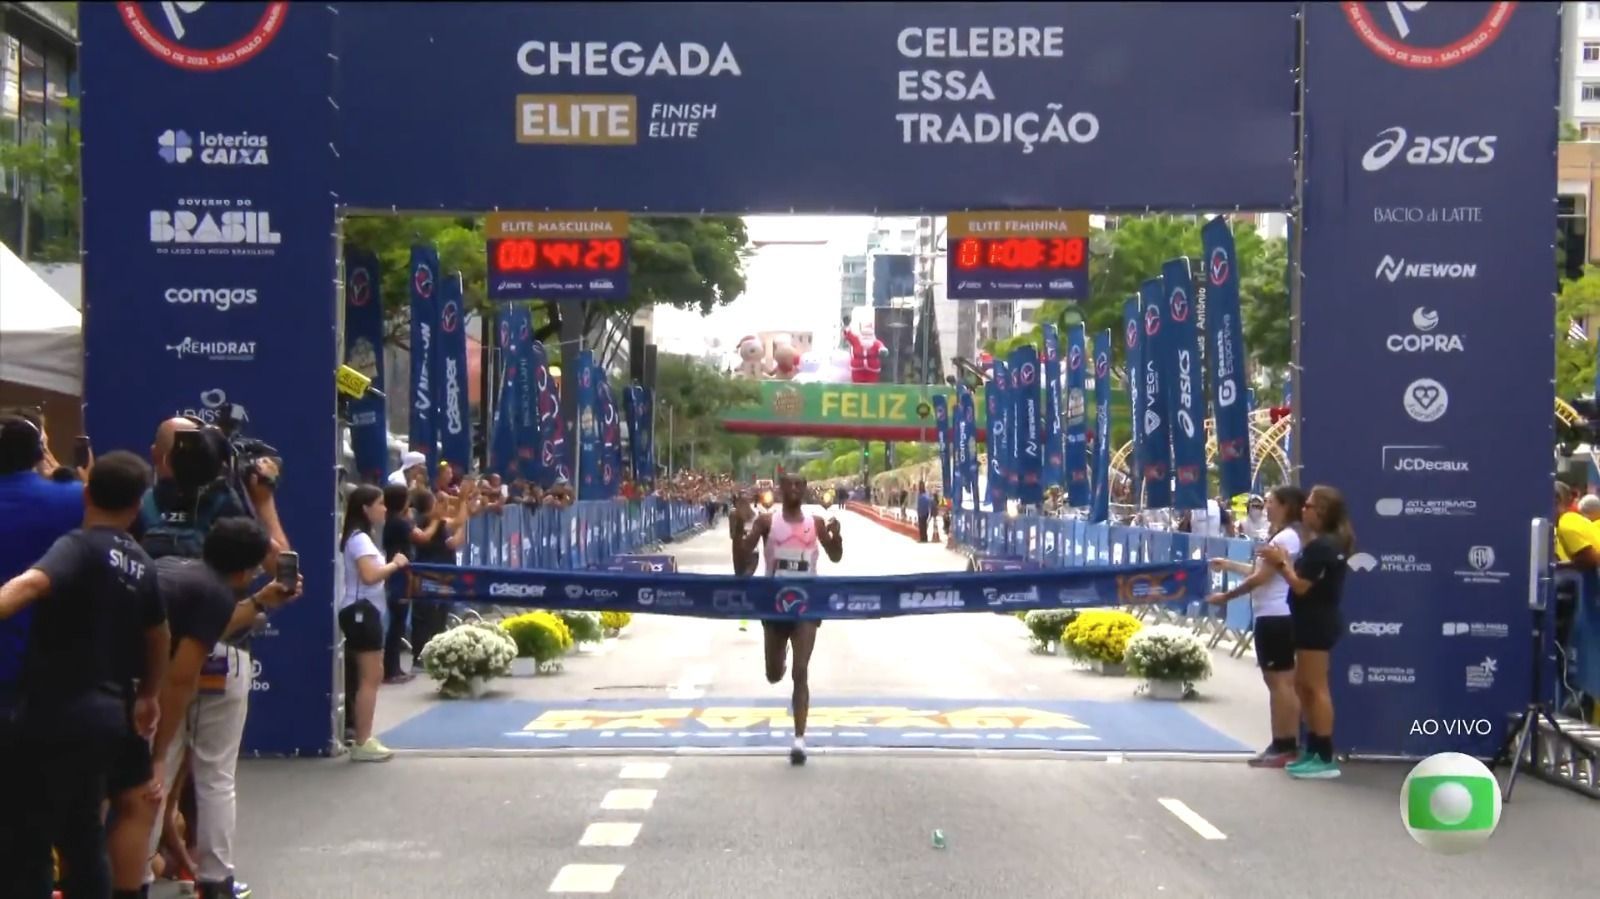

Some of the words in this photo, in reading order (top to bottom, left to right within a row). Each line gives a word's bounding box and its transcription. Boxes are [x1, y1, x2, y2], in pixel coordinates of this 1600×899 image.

[216, 51, 236, 63] SÃO
[235, 35, 262, 57] PAULO
[896, 26, 1064, 59] CELEBRE
[516, 40, 742, 77] CHEGADA
[898, 70, 996, 102] ESSA
[650, 102, 718, 120] FINISH
[521, 103, 631, 138] ELITE
[648, 120, 699, 138] ELITE
[895, 102, 1099, 154] TRADIÇÃO
[200, 131, 269, 148] loterias
[200, 148, 270, 165] CAIXA
[1406, 135, 1498, 164] asics
[178, 198, 230, 206] GOVERNO
[236, 198, 252, 206] DO
[1374, 207, 1423, 222] BACIO
[1427, 207, 1438, 222] di
[1442, 207, 1483, 222] LATTE
[150, 210, 281, 244] BRASIL
[501, 222, 534, 232] ELITE
[538, 222, 613, 232] MASCULINA
[968, 220, 1001, 232] ELITE
[1005, 221, 1068, 232] FEMININA
[1405, 263, 1477, 278] NEWON
[165, 287, 258, 311] comgas
[182, 341, 257, 354] REHIDRAT
[1386, 334, 1465, 352] COPRA
[1146, 360, 1156, 407] VEGA
[1178, 350, 1192, 408] asics
[821, 391, 907, 420] FELIZ
[1394, 458, 1469, 471] JCDecaux
[1380, 554, 1415, 563] WORLD
[1380, 563, 1431, 572] ATHLETICS
[900, 589, 965, 609] BRASIL
